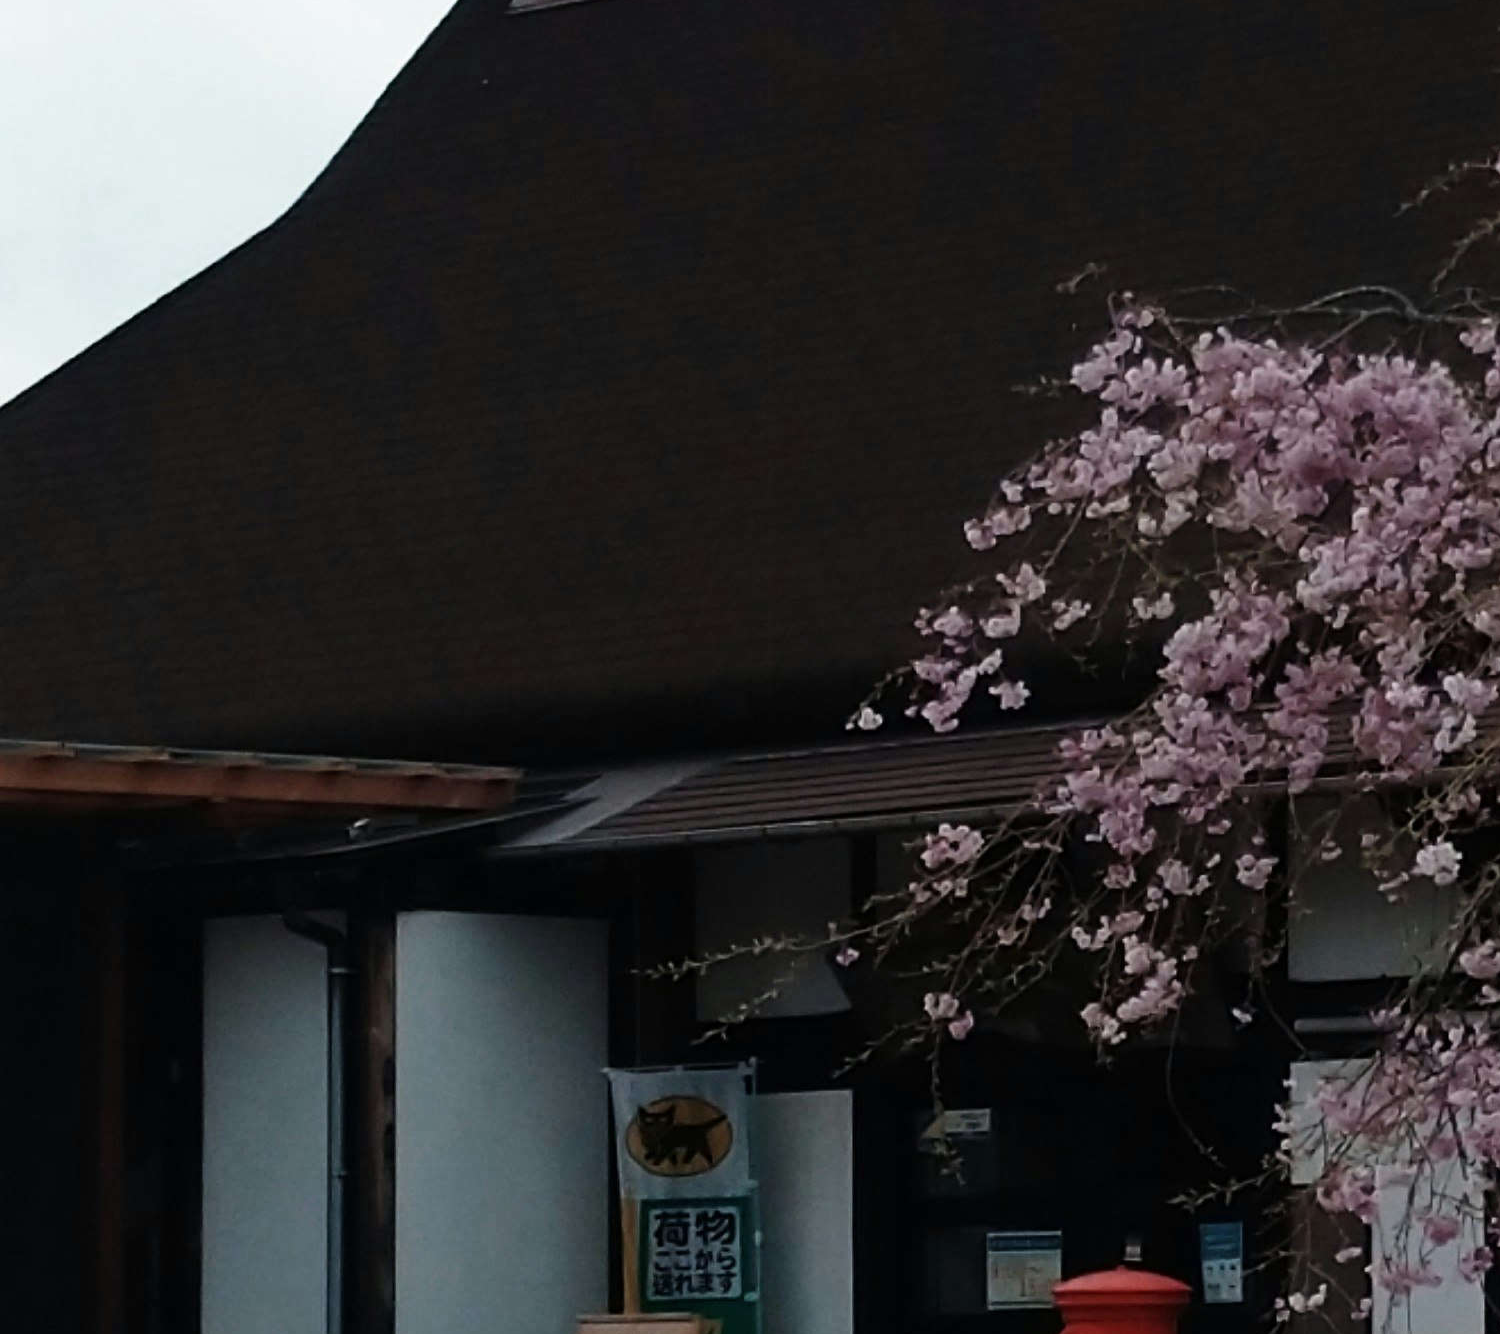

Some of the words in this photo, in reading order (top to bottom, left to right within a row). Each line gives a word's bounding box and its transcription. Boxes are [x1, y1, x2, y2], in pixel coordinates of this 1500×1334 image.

[654, 1210, 735, 1246] 荷物
[654, 1247, 736, 1270] ここから
[653, 1271, 737, 1295] 送れます
